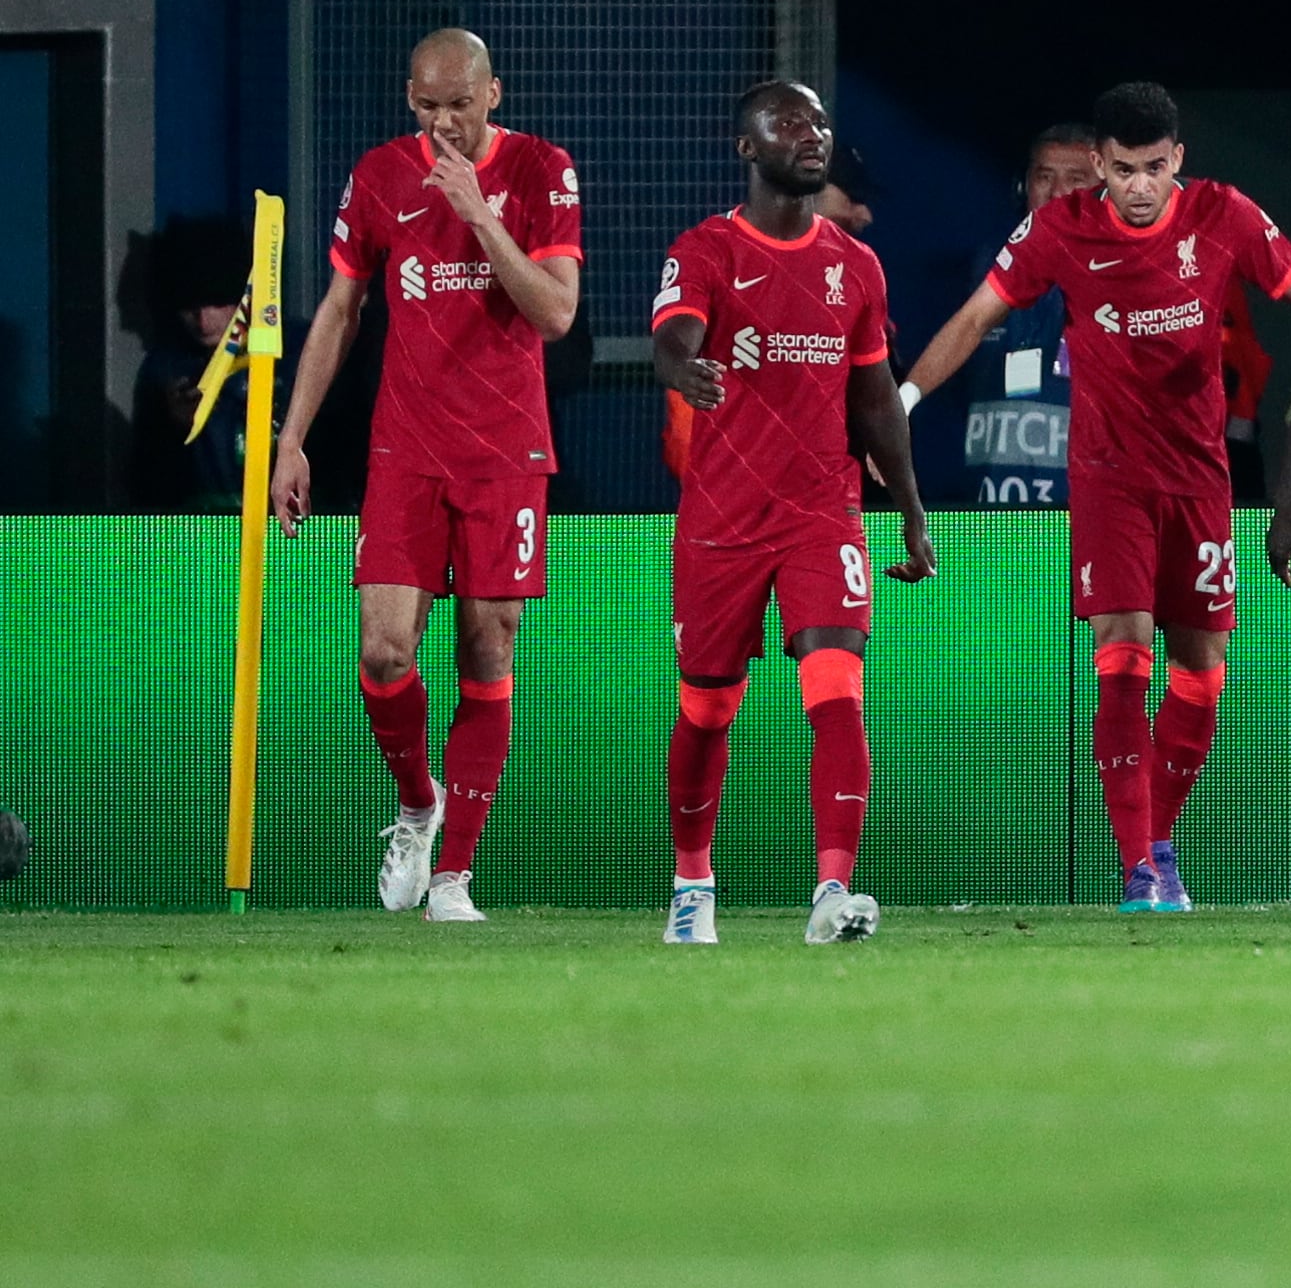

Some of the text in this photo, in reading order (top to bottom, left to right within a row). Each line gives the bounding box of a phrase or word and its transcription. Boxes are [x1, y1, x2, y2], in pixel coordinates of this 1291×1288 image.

[270, 241, 279, 300] VILLARREAL
[431, 260, 493, 277] standa
[431, 276, 492, 292] charter
[1127, 298, 1199, 324] standard
[1127, 311, 1204, 337] chartered
[767, 332, 845, 350] standard
[964, 410, 1070, 457] PITCH
[516, 507, 536, 564] 3
[838, 543, 868, 598] 8
[1195, 539, 1237, 595] 23
[1099, 754, 1140, 770] LFC
